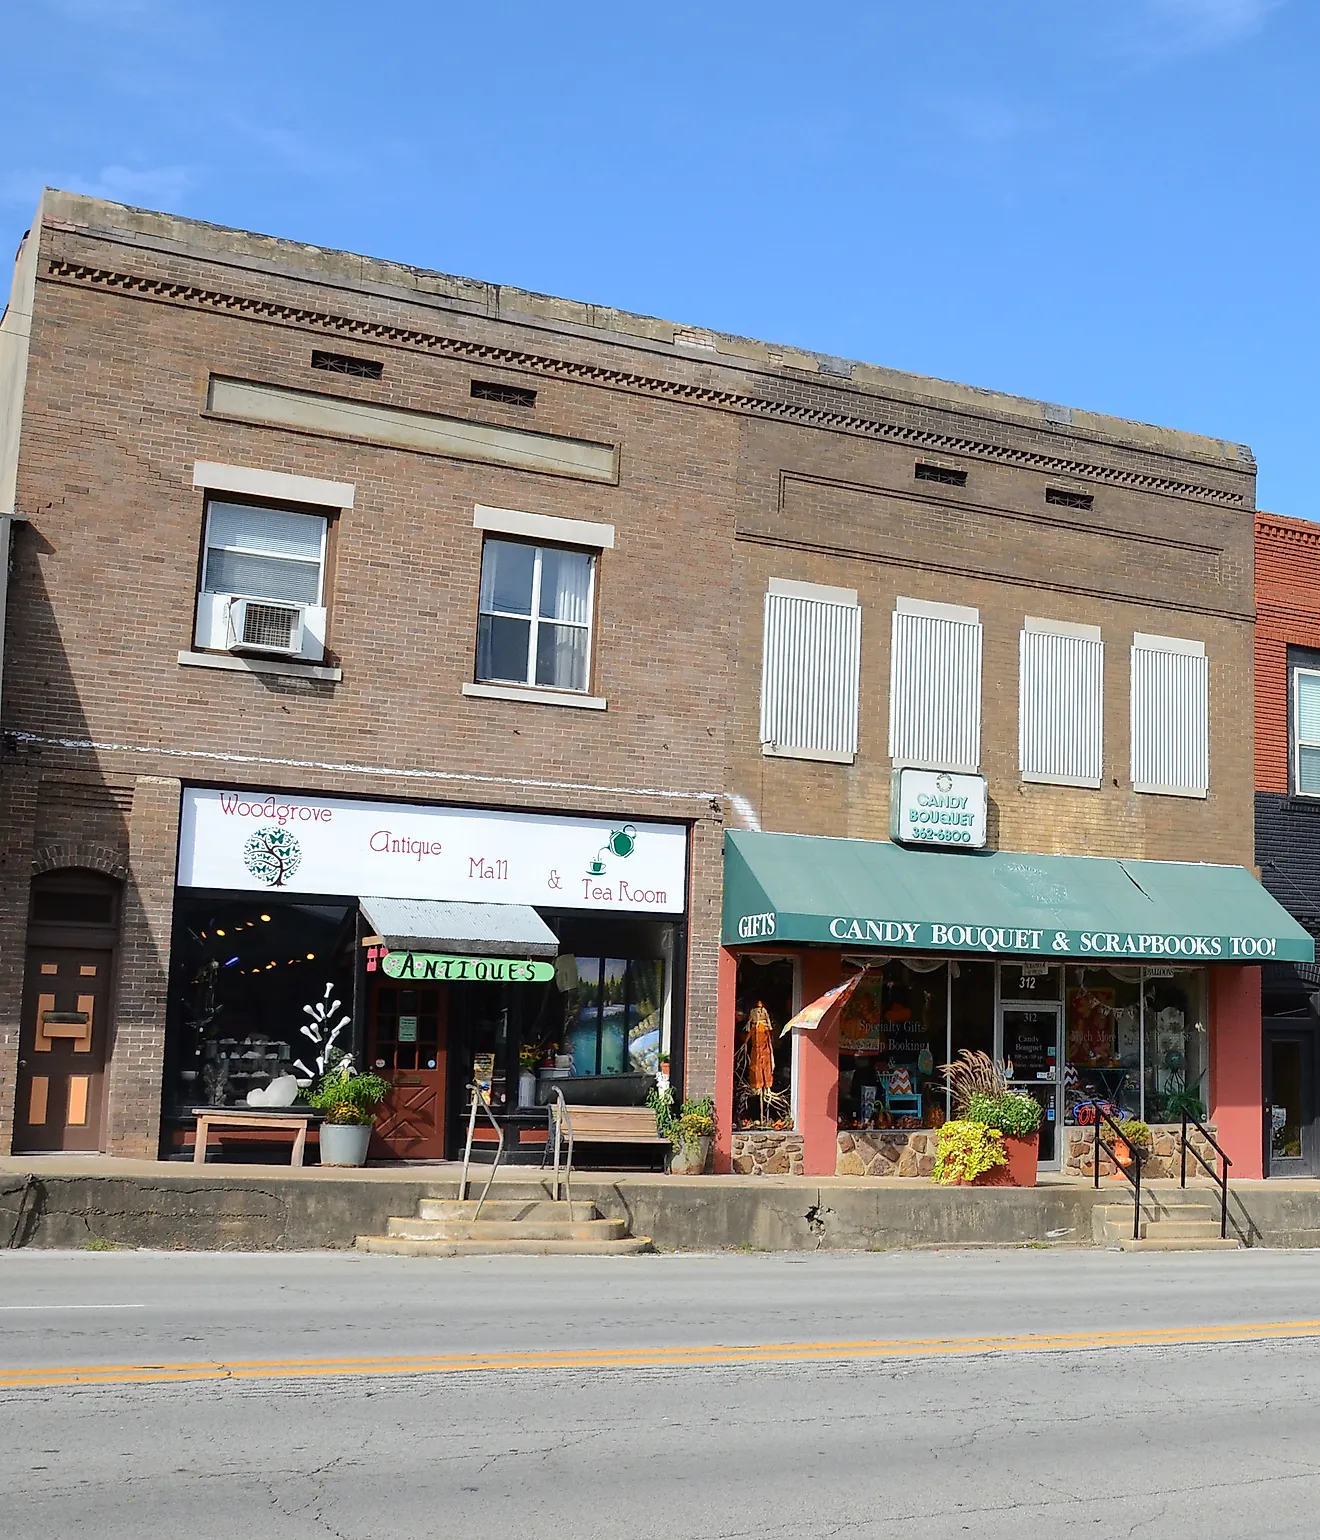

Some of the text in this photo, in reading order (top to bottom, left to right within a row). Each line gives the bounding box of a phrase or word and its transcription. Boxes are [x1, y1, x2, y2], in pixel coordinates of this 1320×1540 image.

[219, 793, 332, 825] Woodgrove
[917, 793, 968, 809] CANDY
[909, 809, 974, 826] BOUQUET
[912, 827, 971, 842] 362-6800
[369, 830, 442, 861] Antique
[468, 857, 508, 880] Mall
[547, 869, 667, 904] & Tea Room
[738, 912, 776, 938] GIFTS
[829, 917, 1277, 956] CANDY BOUQUET & SCRAPBOOKS TOO!
[400, 953, 536, 981] ANTIQUES
[1019, 977, 1036, 989] 312
[1023, 1013, 1037, 1022] 312
[859, 1020, 926, 1035] Specialty Gifts
[888, 1039, 925, 1052] Booking
[1016, 1043, 1042, 1053] Bouquet
[1018, 1035, 1039, 1045] Candy
